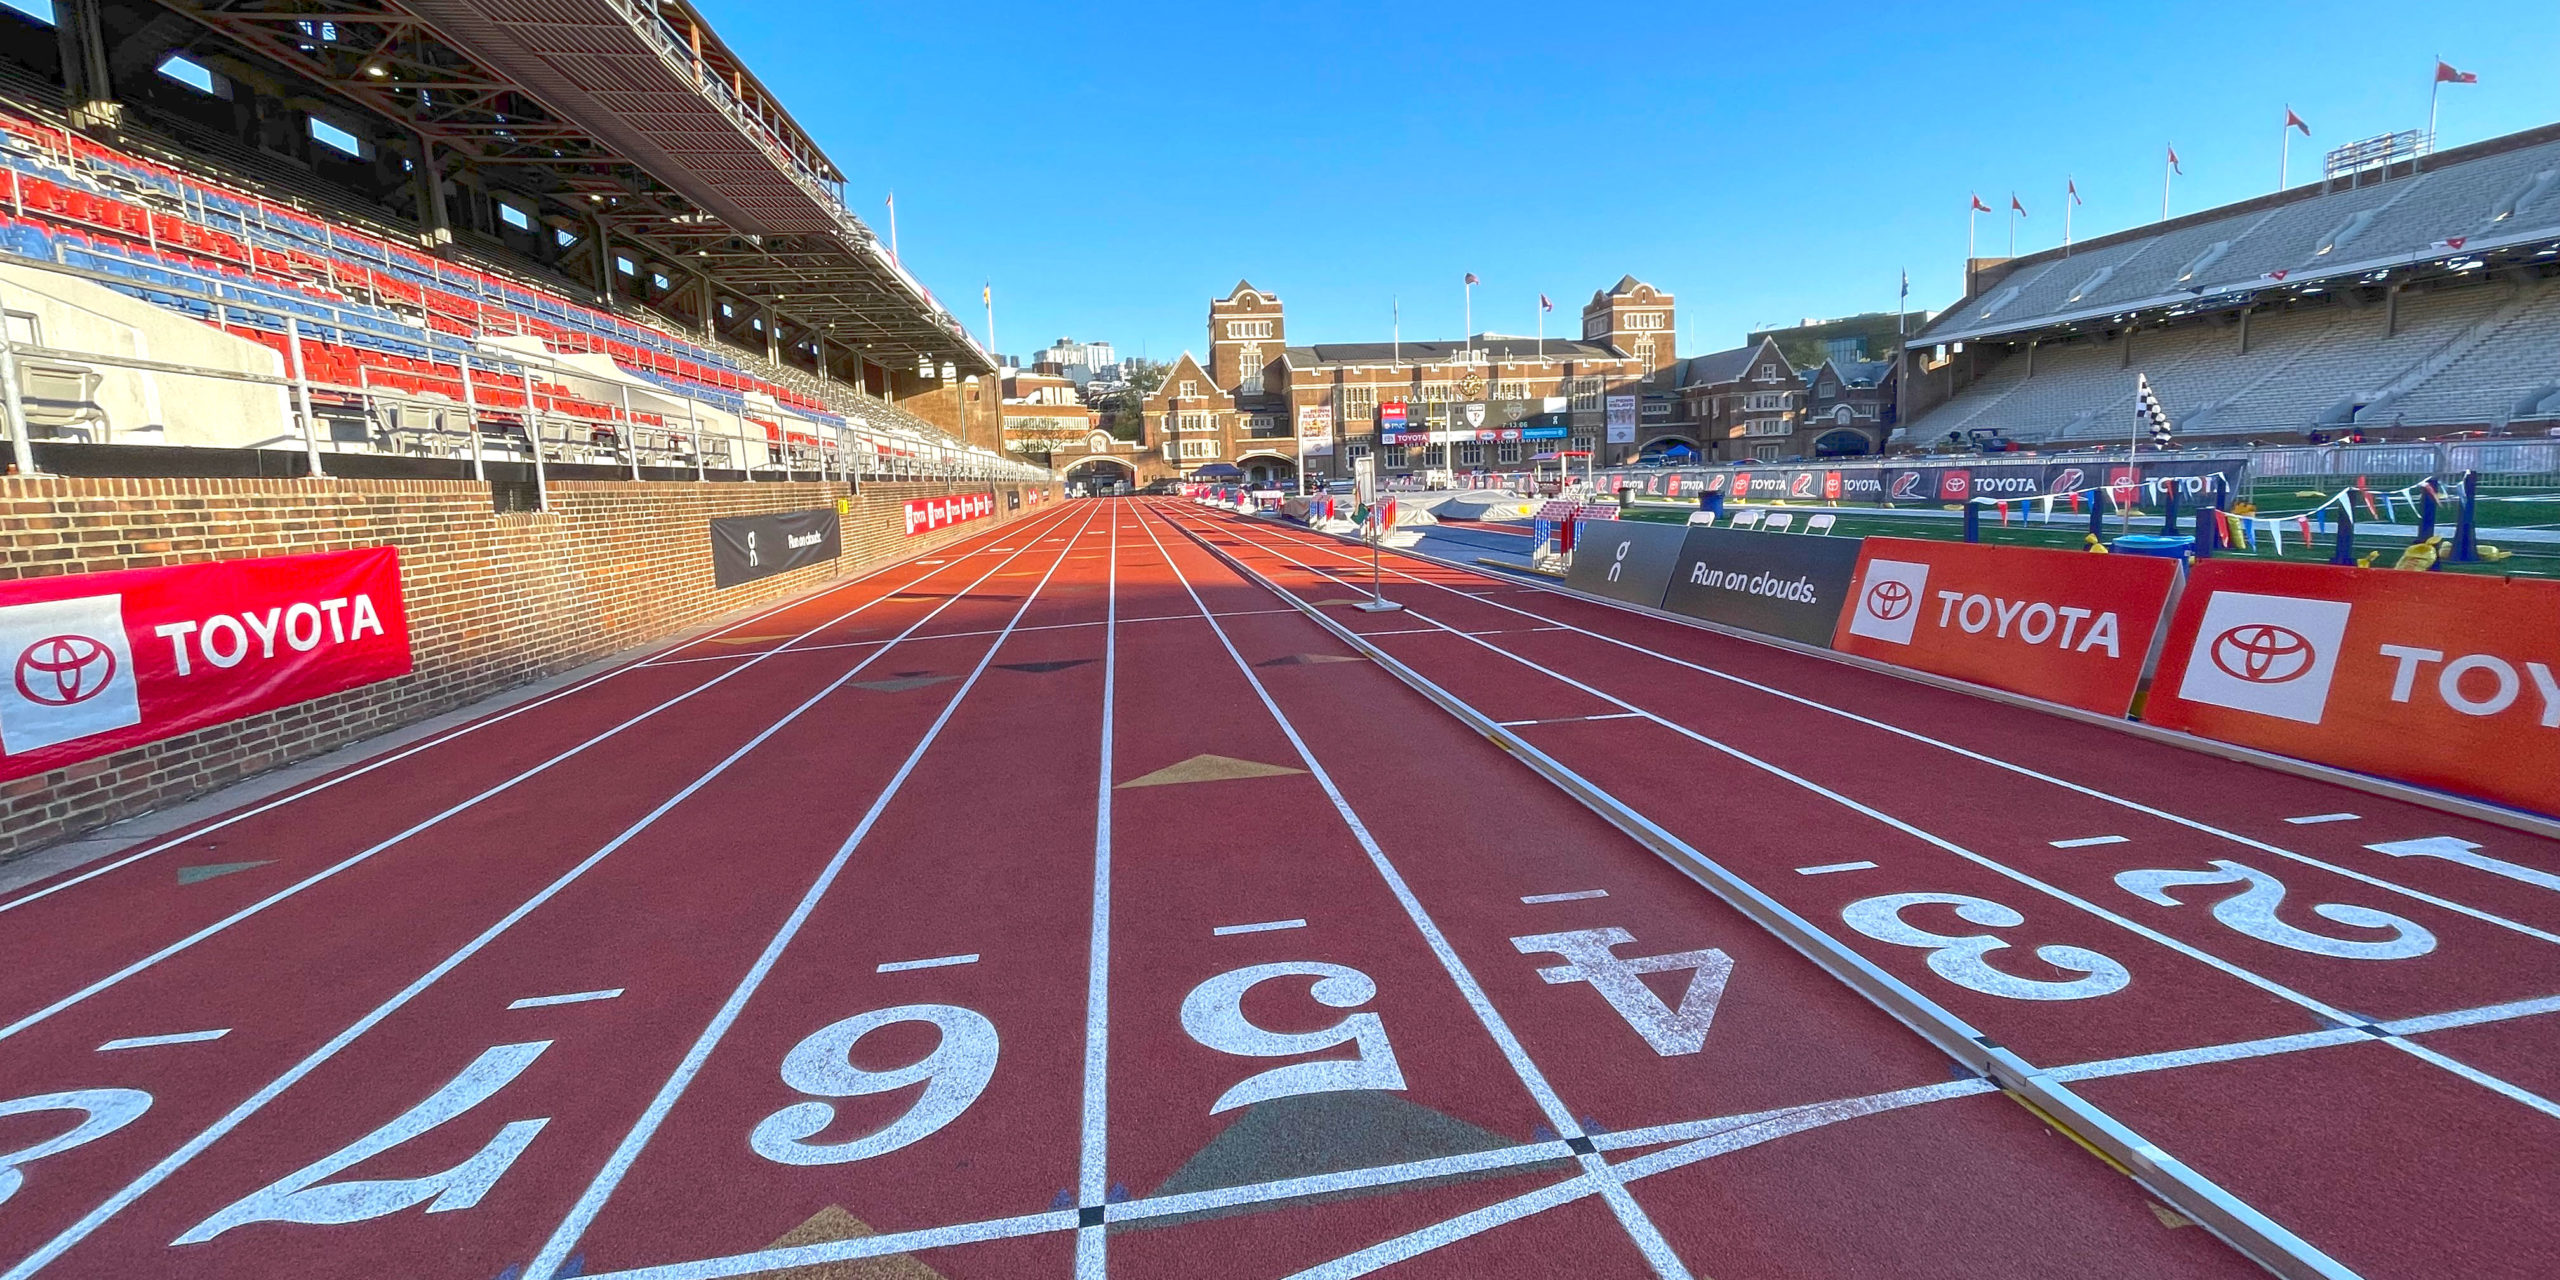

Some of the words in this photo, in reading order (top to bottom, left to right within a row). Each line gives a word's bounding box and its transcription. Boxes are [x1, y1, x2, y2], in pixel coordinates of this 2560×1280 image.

[1393, 394, 1463, 403] FRANKLIN
[1493, 392, 1532, 401] FIELD
[1398, 434, 1428, 443] TOYOTA
[1751, 478, 1787, 491] TOYOTA
[1843, 478, 1882, 492] TOYOTA
[1974, 477, 2038, 493] TOYOTA
[1690, 561, 1724, 588] Run
[1725, 572, 1748, 592] on
[1749, 571, 1817, 604] clouds.
[154, 593, 385, 677] TOYOTA
[1938, 590, 2121, 659] TOYOTA
[2113, 860, 2438, 960] 2
[1842, 892, 2131, 1000] 3
[1509, 926, 1736, 1056] 4
[1180, 961, 1407, 1116] 5
[168, 1039, 555, 1247] 7
